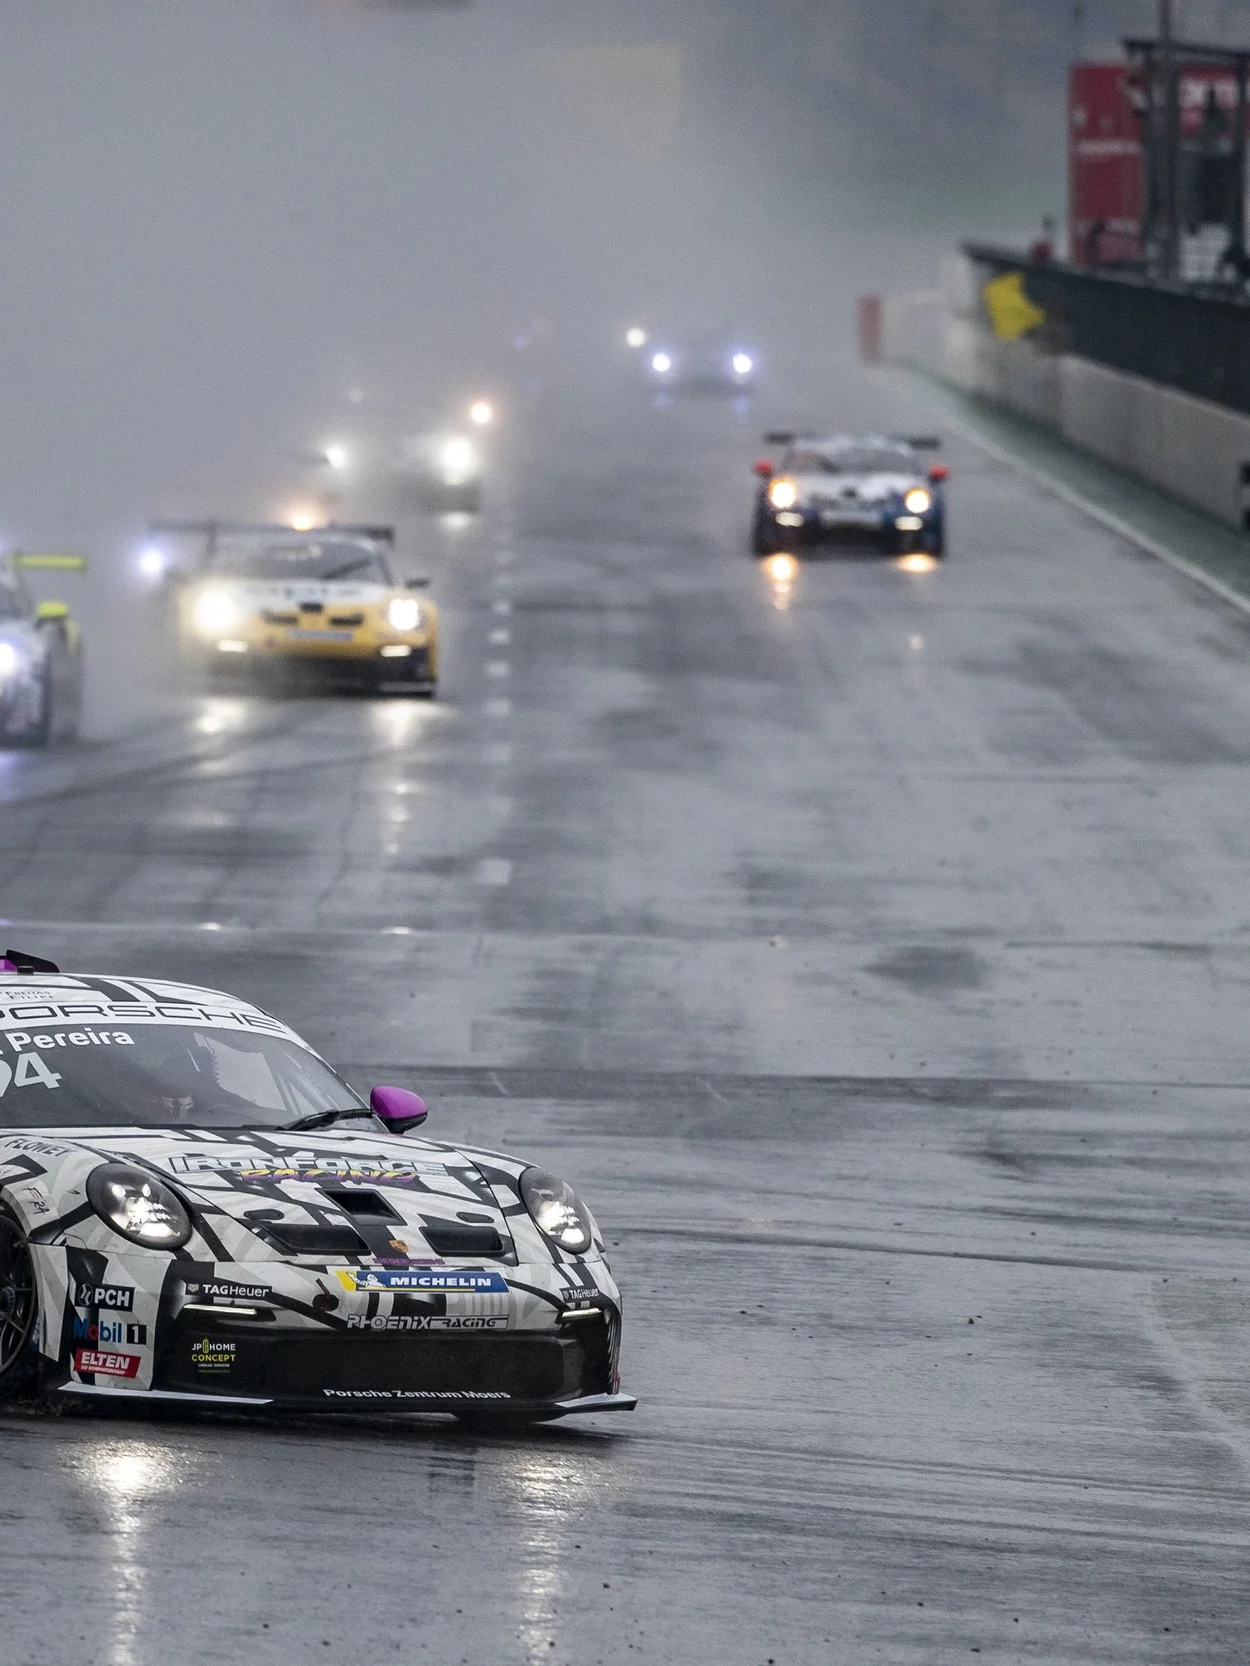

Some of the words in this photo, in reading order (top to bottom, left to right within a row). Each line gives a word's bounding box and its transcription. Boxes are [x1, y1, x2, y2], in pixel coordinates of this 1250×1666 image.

[6, 1028, 135, 1052] Pereira
[169, 1157, 450, 1173] IRONFORCE
[390, 1277, 491, 1286] MICHELIN
[94, 1289, 129, 1307] PCH
[73, 1318, 122, 1344] Mobil
[131, 1326, 141, 1343] 1
[209, 1343, 236, 1351] HOME
[81, 1351, 130, 1370] ELTEN
[191, 1353, 236, 1362] CONCEPT
[323, 1389, 393, 1399] Porsche
[391, 1389, 462, 1399] Zentrum
[461, 1391, 511, 1399] Moers
